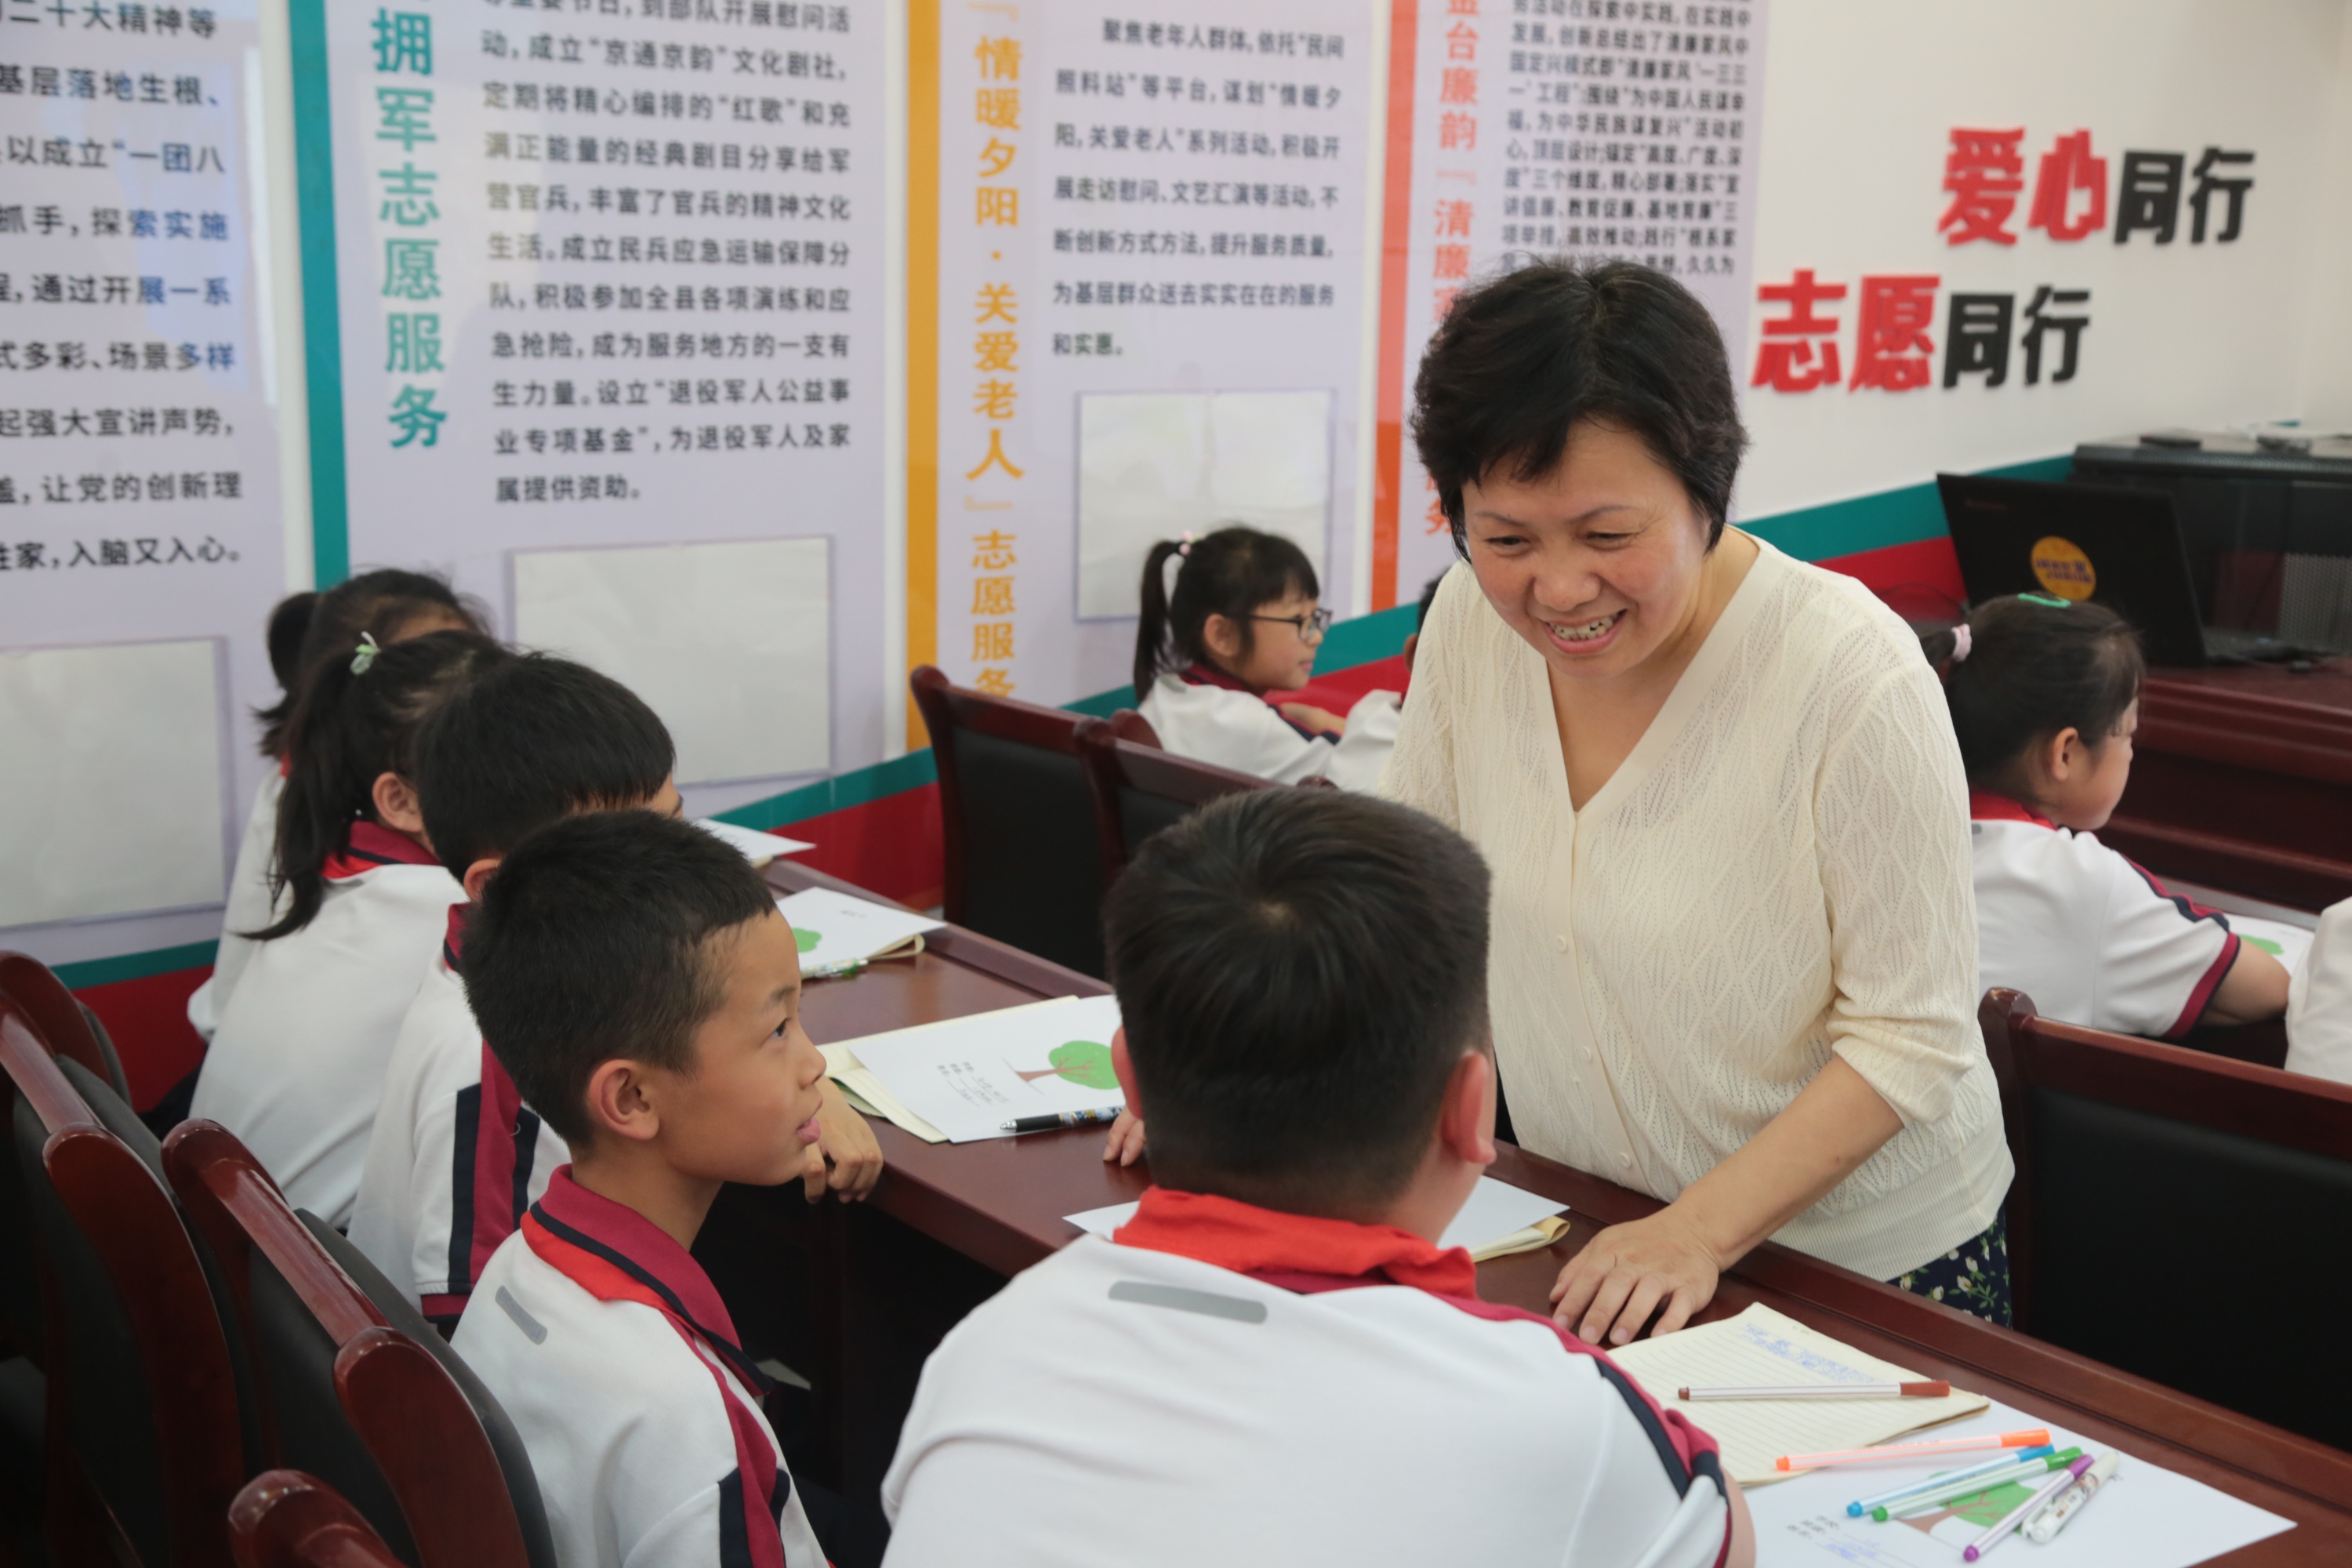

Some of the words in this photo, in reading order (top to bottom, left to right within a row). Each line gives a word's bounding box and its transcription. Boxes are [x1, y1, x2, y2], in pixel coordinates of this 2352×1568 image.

[0, 0, 216, 39] 二十大精神等
[0, 63, 218, 105] 基层落地生根、
[483, 81, 851, 128] 定期将精心编排的“红歌”和充
[486, 132, 851, 173] 满正能量的经典剧目分享给军
[486, 183, 851, 220] 营官兵，丰富了官兵的精神文化
[1937, 127, 2256, 246] 爱心同行
[370, 7, 448, 449] 拥军志愿服务
[488, 233, 851, 267] 生活。成立民兵应急运输保障分
[490, 282, 850, 312] 队，积极参加全县各项演练和应
[1053, 281, 1334, 307] 为基层群众送去实实在在的服务
[491, 332, 850, 358] 急抢险，成为服务地方的一支有
[1052, 332, 1122, 356] 和实惠。
[1751, 268, 2091, 394] 志愿同行
[492, 378, 851, 407] 生力量。设立“退役军人公益事
[495, 423, 851, 455] 业专项基金”，为退役军人及家
[495, 474, 640, 503] 属提供资助。
